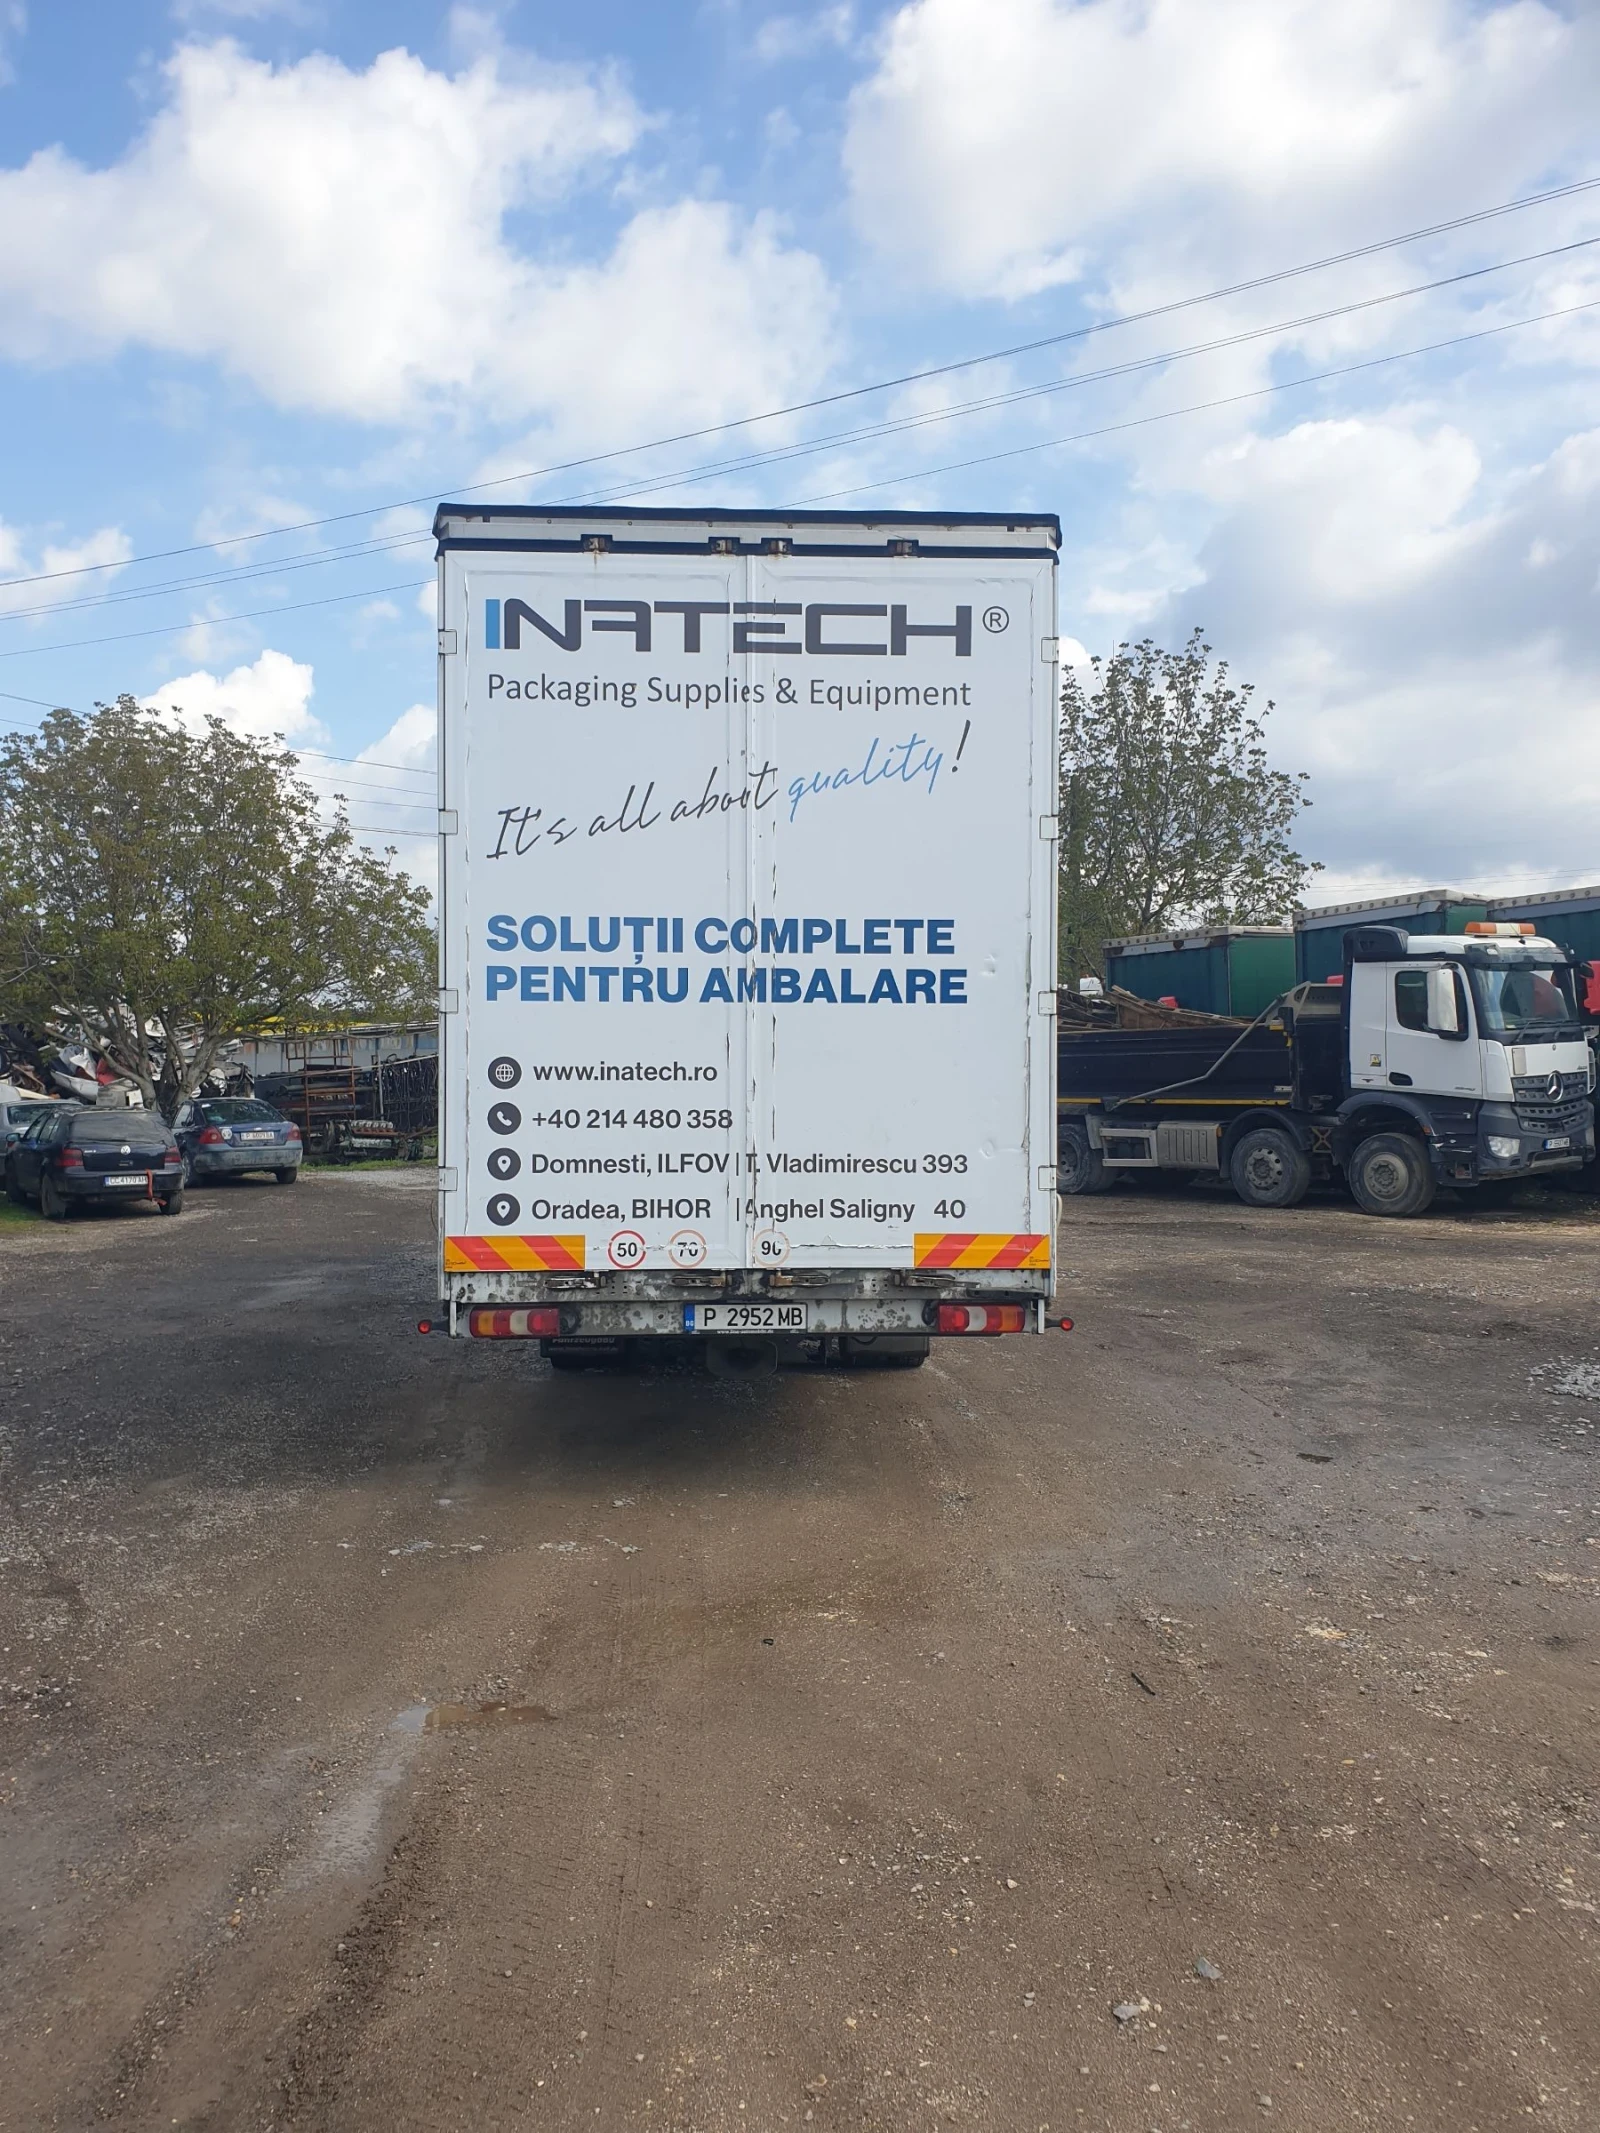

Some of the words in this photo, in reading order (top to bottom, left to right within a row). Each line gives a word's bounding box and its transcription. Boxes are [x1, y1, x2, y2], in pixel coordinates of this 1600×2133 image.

[485, 598, 972, 656] INATECH
[489, 673, 637, 708] Packaging
[648, 676, 764, 709] Supplies
[776, 678, 798, 704] &
[811, 680, 971, 711] Equipment
[487, 807, 577, 859] It's
[588, 782, 661, 834] all
[670, 761, 778, 821] about
[789, 720, 970, 821] quality!
[694, 917, 955, 954] COMPLETE
[487, 966, 688, 1002] PENTRU
[699, 965, 967, 1004] AMBALARE
[533, 1061, 717, 1081] www.inatech.ro
[533, 1109, 580, 1128] +40
[587, 1109, 627, 1128] 214
[634, 1109, 681, 1128] 480
[687, 1109, 733, 1130] 358
[532, 1154, 651, 1177] Domnesti,
[658, 1153, 729, 1173] ILFOV
[767, 1153, 916, 1173] Vladimirescu
[923, 1154, 967, 1173] 393
[532, 1199, 625, 1222] Oradea,
[632, 1199, 710, 1219] BIHOR
[745, 1199, 824, 1222] Anghel
[830, 1199, 915, 1222] Saligny
[934, 1200, 965, 1218] 40
[617, 1242, 637, 1257] 50
[678, 1242, 698, 1257] 70
[704, 1308, 716, 1326] P
[727, 1308, 773, 1326] 2952
[778, 1308, 802, 1326] MB
